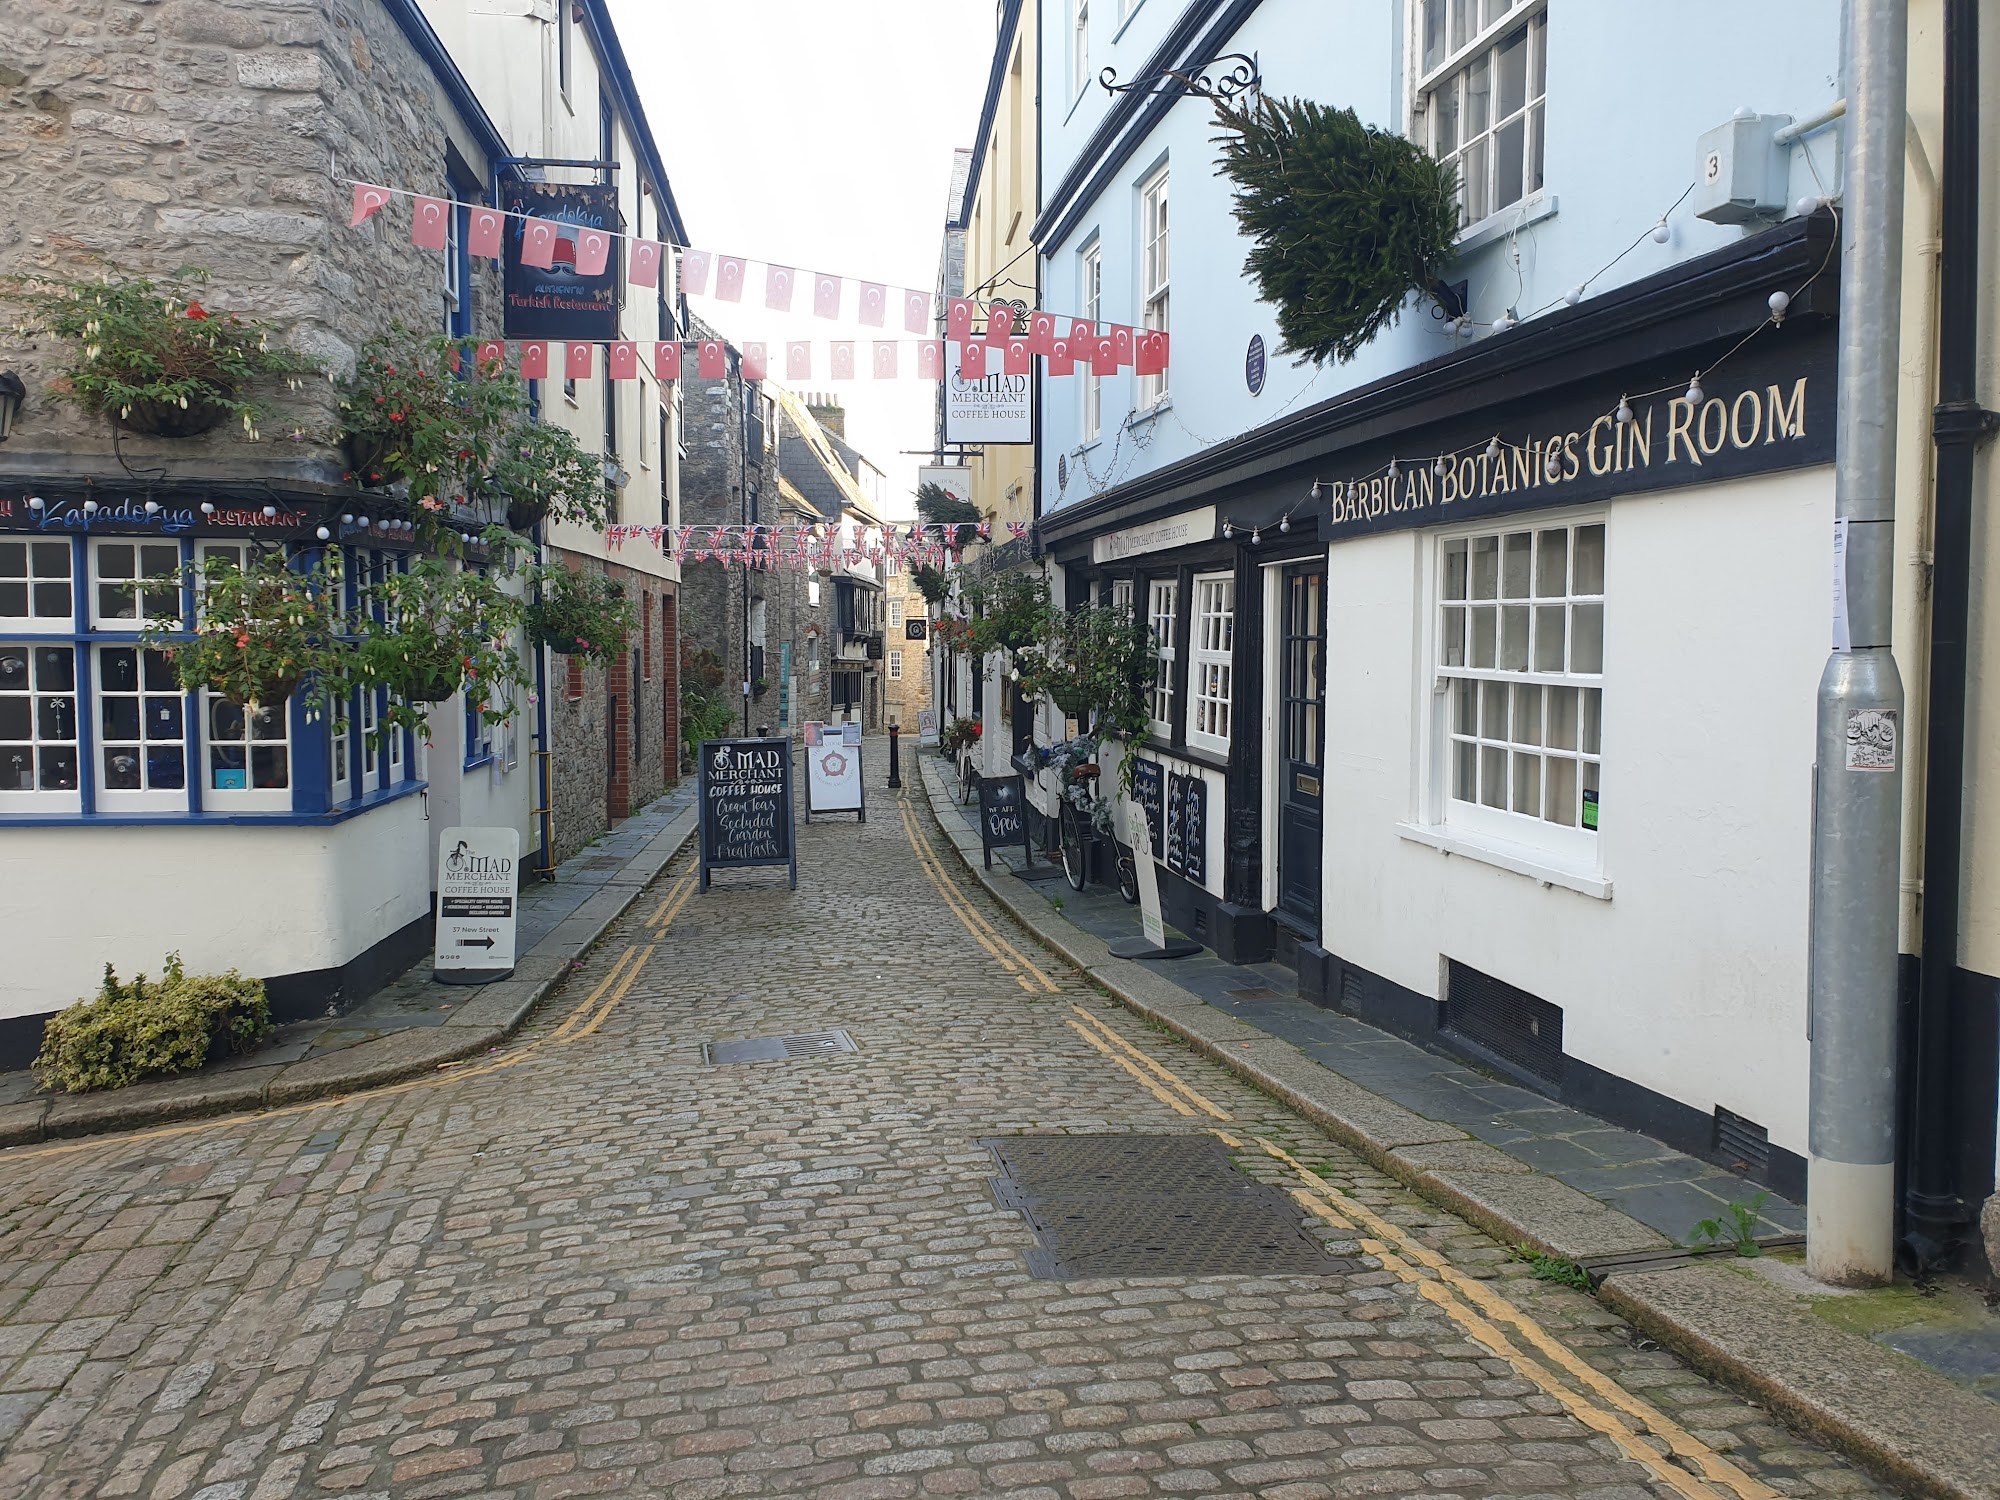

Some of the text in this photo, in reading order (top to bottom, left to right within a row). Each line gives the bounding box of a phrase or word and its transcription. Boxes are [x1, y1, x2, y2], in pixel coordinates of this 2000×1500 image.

[1708, 155, 1718, 178] 3
[509, 293, 611, 312] Turkish Restaurant
[978, 373, 1026, 393] MAD
[952, 393, 1026, 403] MERCHANT
[952, 410, 1026, 419] COFFEE HOUSE
[1331, 377, 1807, 525] BARBICAN BOTANICS GIN ROOM
[1130, 531, 1155, 550] MERCHANT
[1155, 529, 1171, 543] COFFEE
[1171, 524, 1188, 538] HOUSE
[737, 751, 780, 769] MAD
[708, 768, 784, 780] MERCHANT
[709, 784, 783, 798] COFFEE HOUSE
[717, 796, 776, 817] Cream Teas
[720, 812, 774, 830] Secluded
[988, 813, 1021, 838] Open
[729, 828, 772, 843] Garden
[470, 856, 511, 872] MAD
[446, 873, 511, 881] MERCHANT
